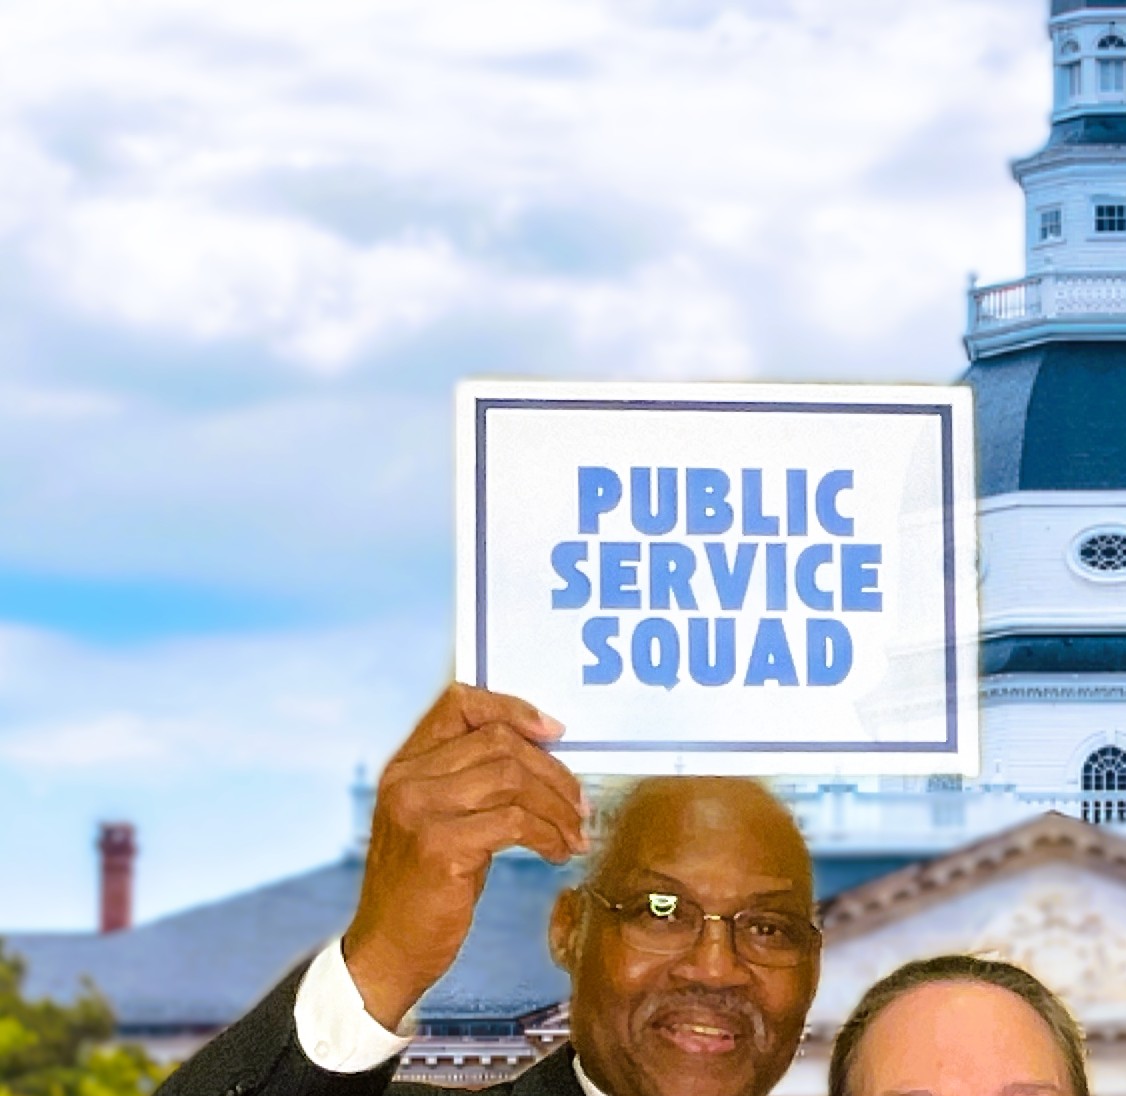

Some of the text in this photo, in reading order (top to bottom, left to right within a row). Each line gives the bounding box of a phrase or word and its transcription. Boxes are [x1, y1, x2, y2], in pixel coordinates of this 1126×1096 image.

[578, 466, 854, 537] PUBLIC
[551, 542, 882, 612] SERVICE
[582, 617, 853, 690] SQUAD
